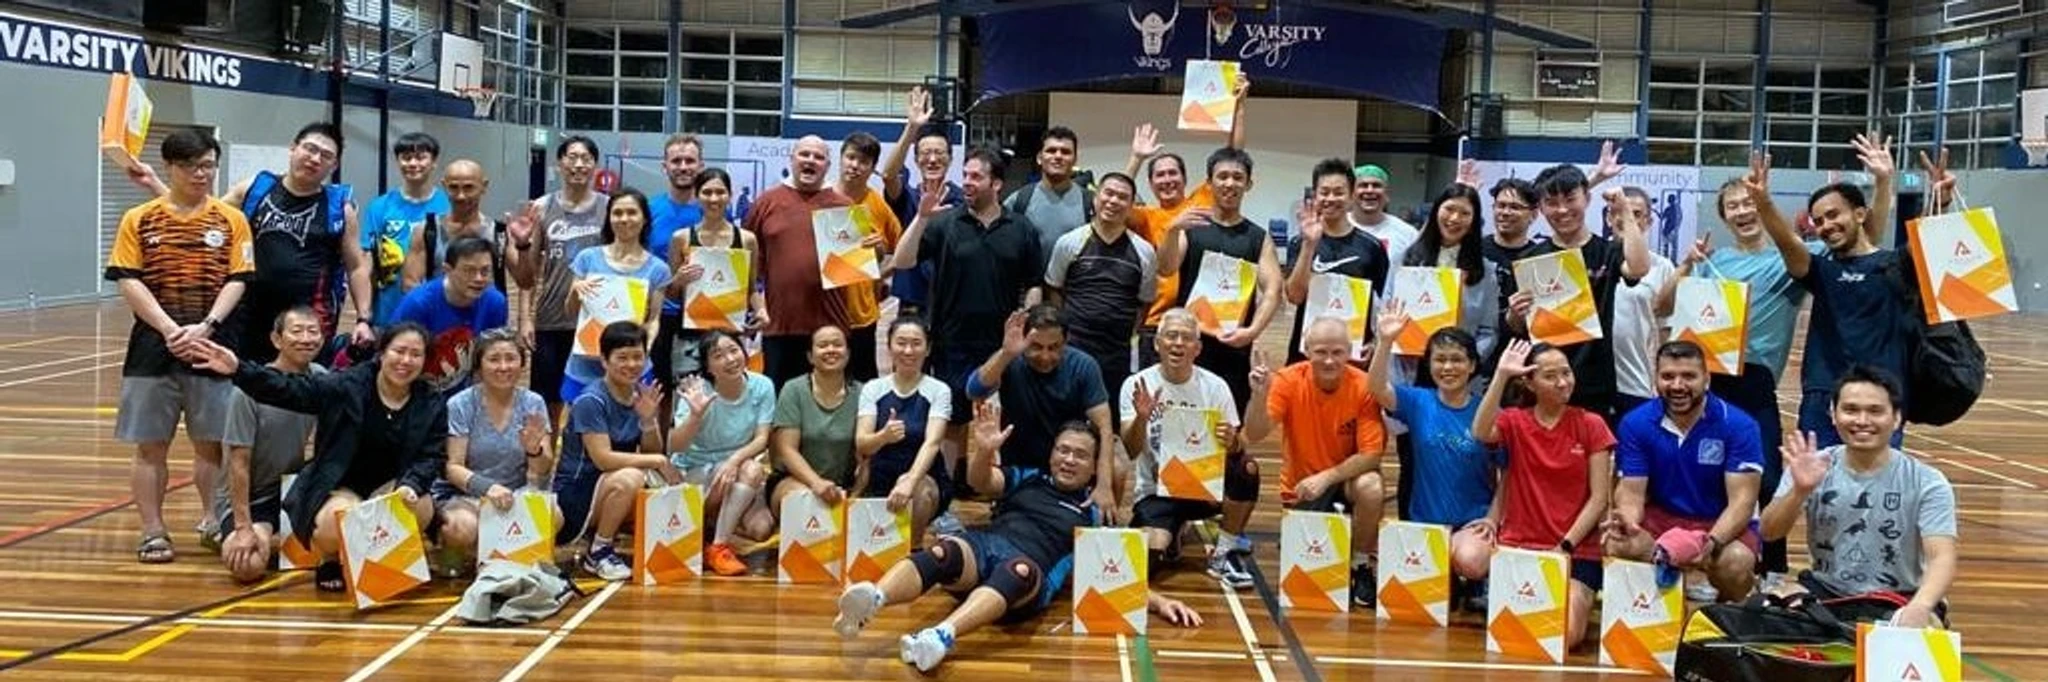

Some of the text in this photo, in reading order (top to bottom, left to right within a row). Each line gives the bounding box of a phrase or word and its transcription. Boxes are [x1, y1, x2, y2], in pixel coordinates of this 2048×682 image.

[0, 21, 241, 87] VARSITY VIKINGS
[1244, 24, 1326, 42] VARSITY
